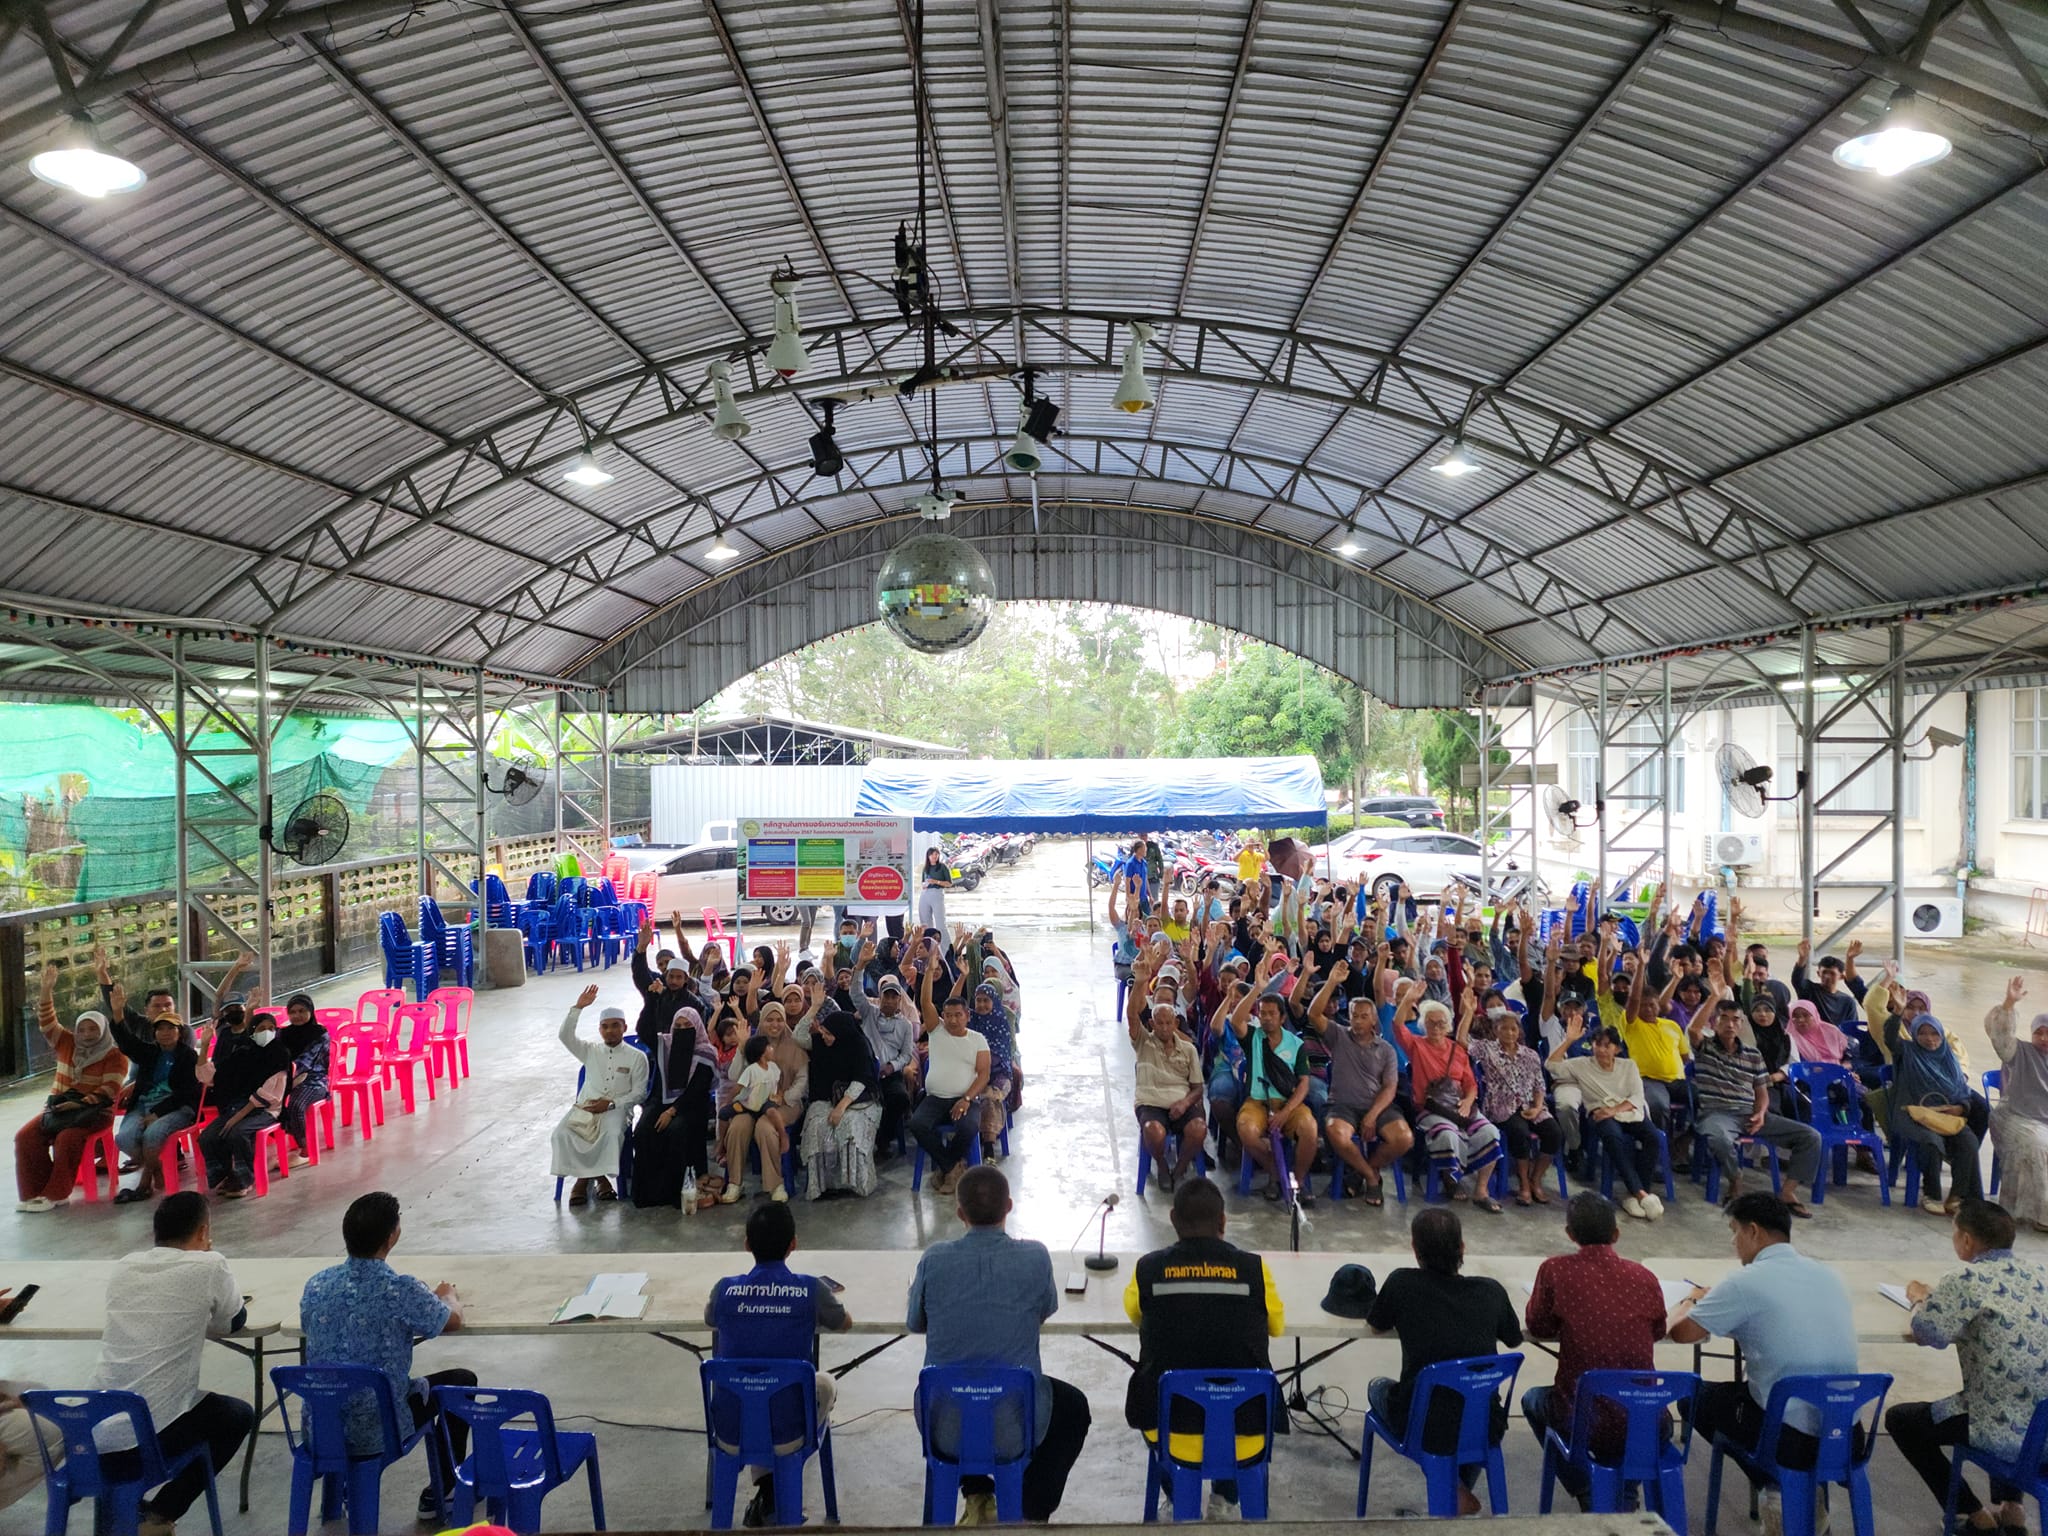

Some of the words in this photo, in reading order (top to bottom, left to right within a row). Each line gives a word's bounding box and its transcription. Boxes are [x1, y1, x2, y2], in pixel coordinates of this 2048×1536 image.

[1164, 1261, 1238, 1280] กรมการปกครอง
[725, 1282, 809, 1298] กรมการปกครอง
[737, 1302, 792, 1314] อำเภอระแงะ
